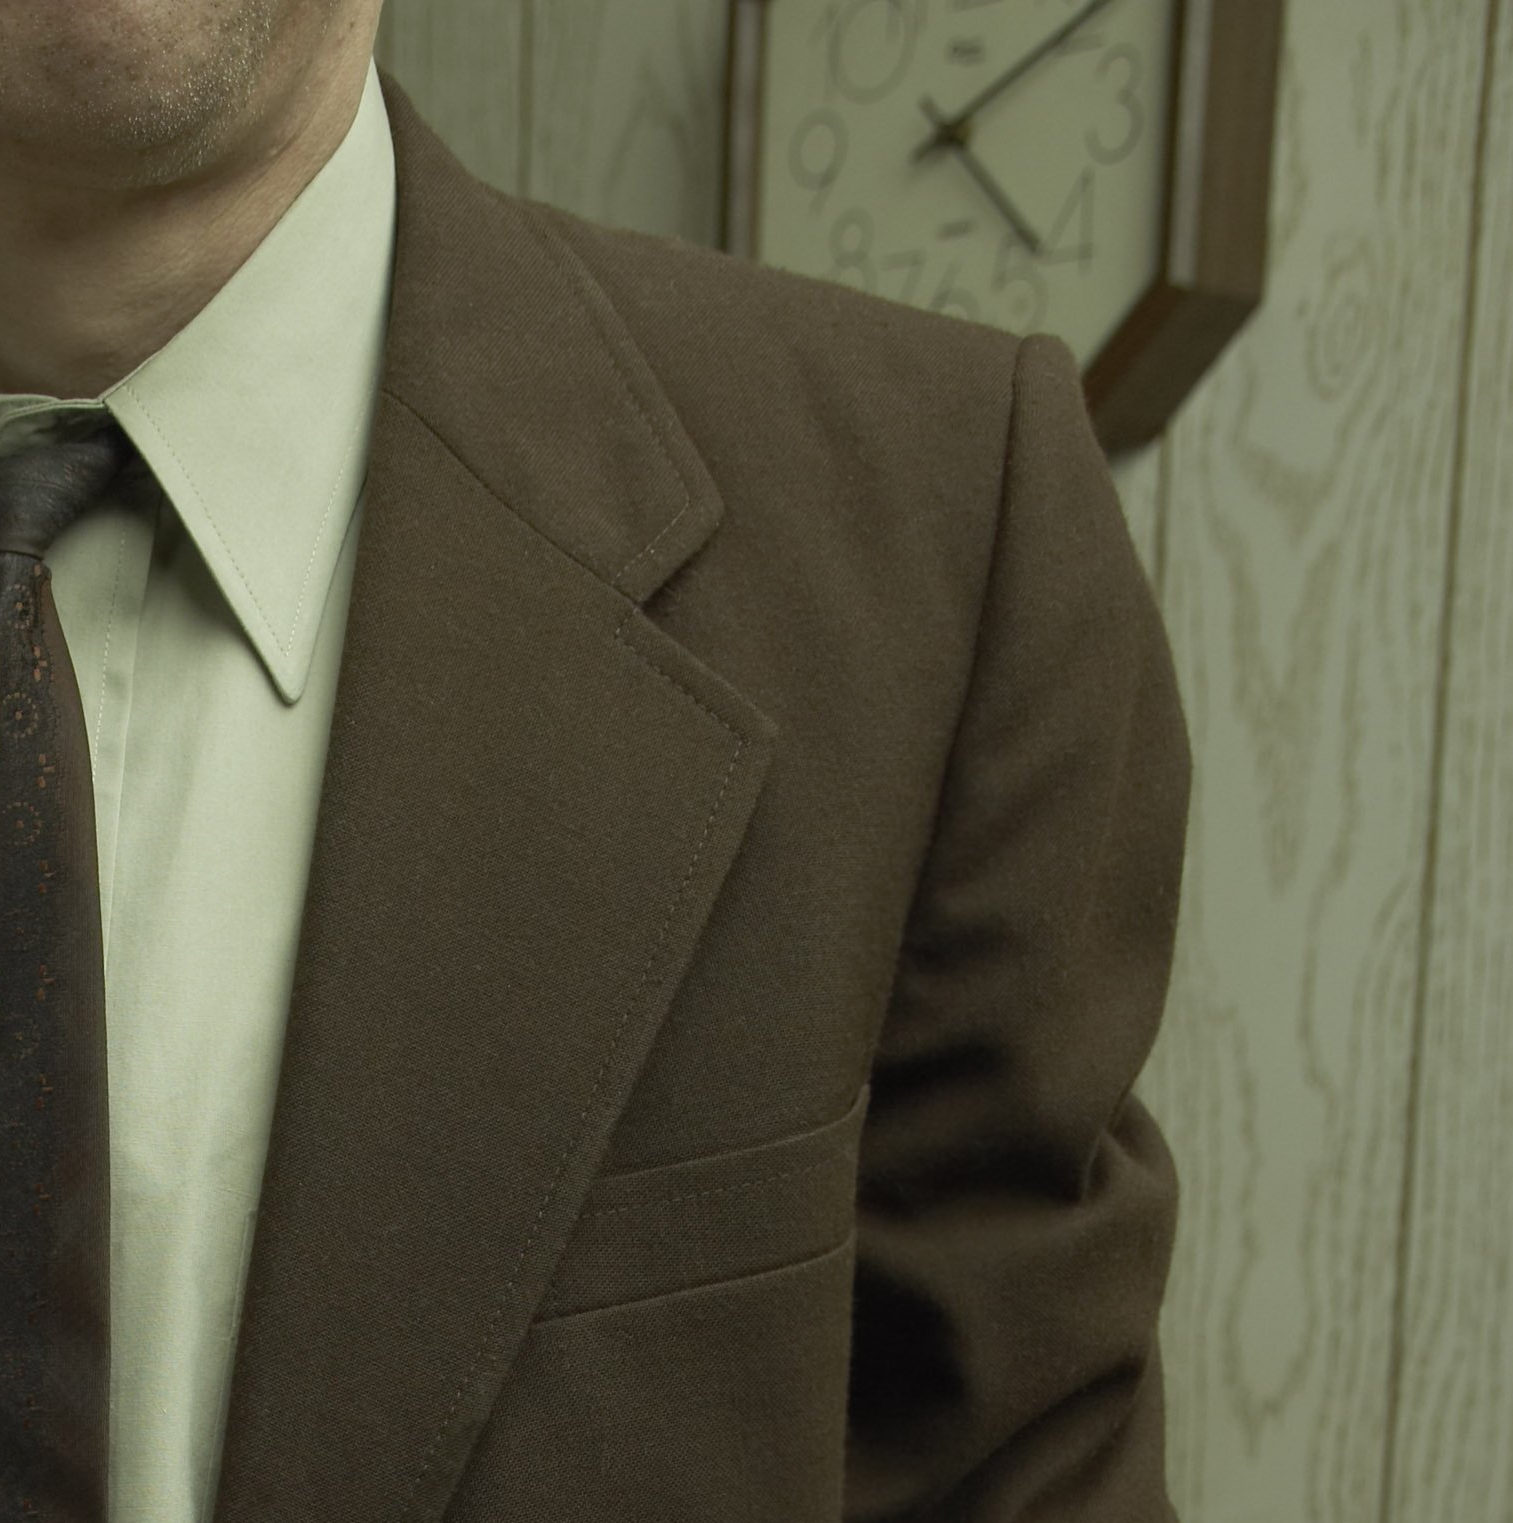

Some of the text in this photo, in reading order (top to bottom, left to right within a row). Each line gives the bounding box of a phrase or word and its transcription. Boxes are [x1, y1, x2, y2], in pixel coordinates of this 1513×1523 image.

[1084, 41, 1145, 166] 3
[788, 106, 850, 218] 9
[827, 206, 879, 292] 8
[1037, 165, 1096, 276] 4
